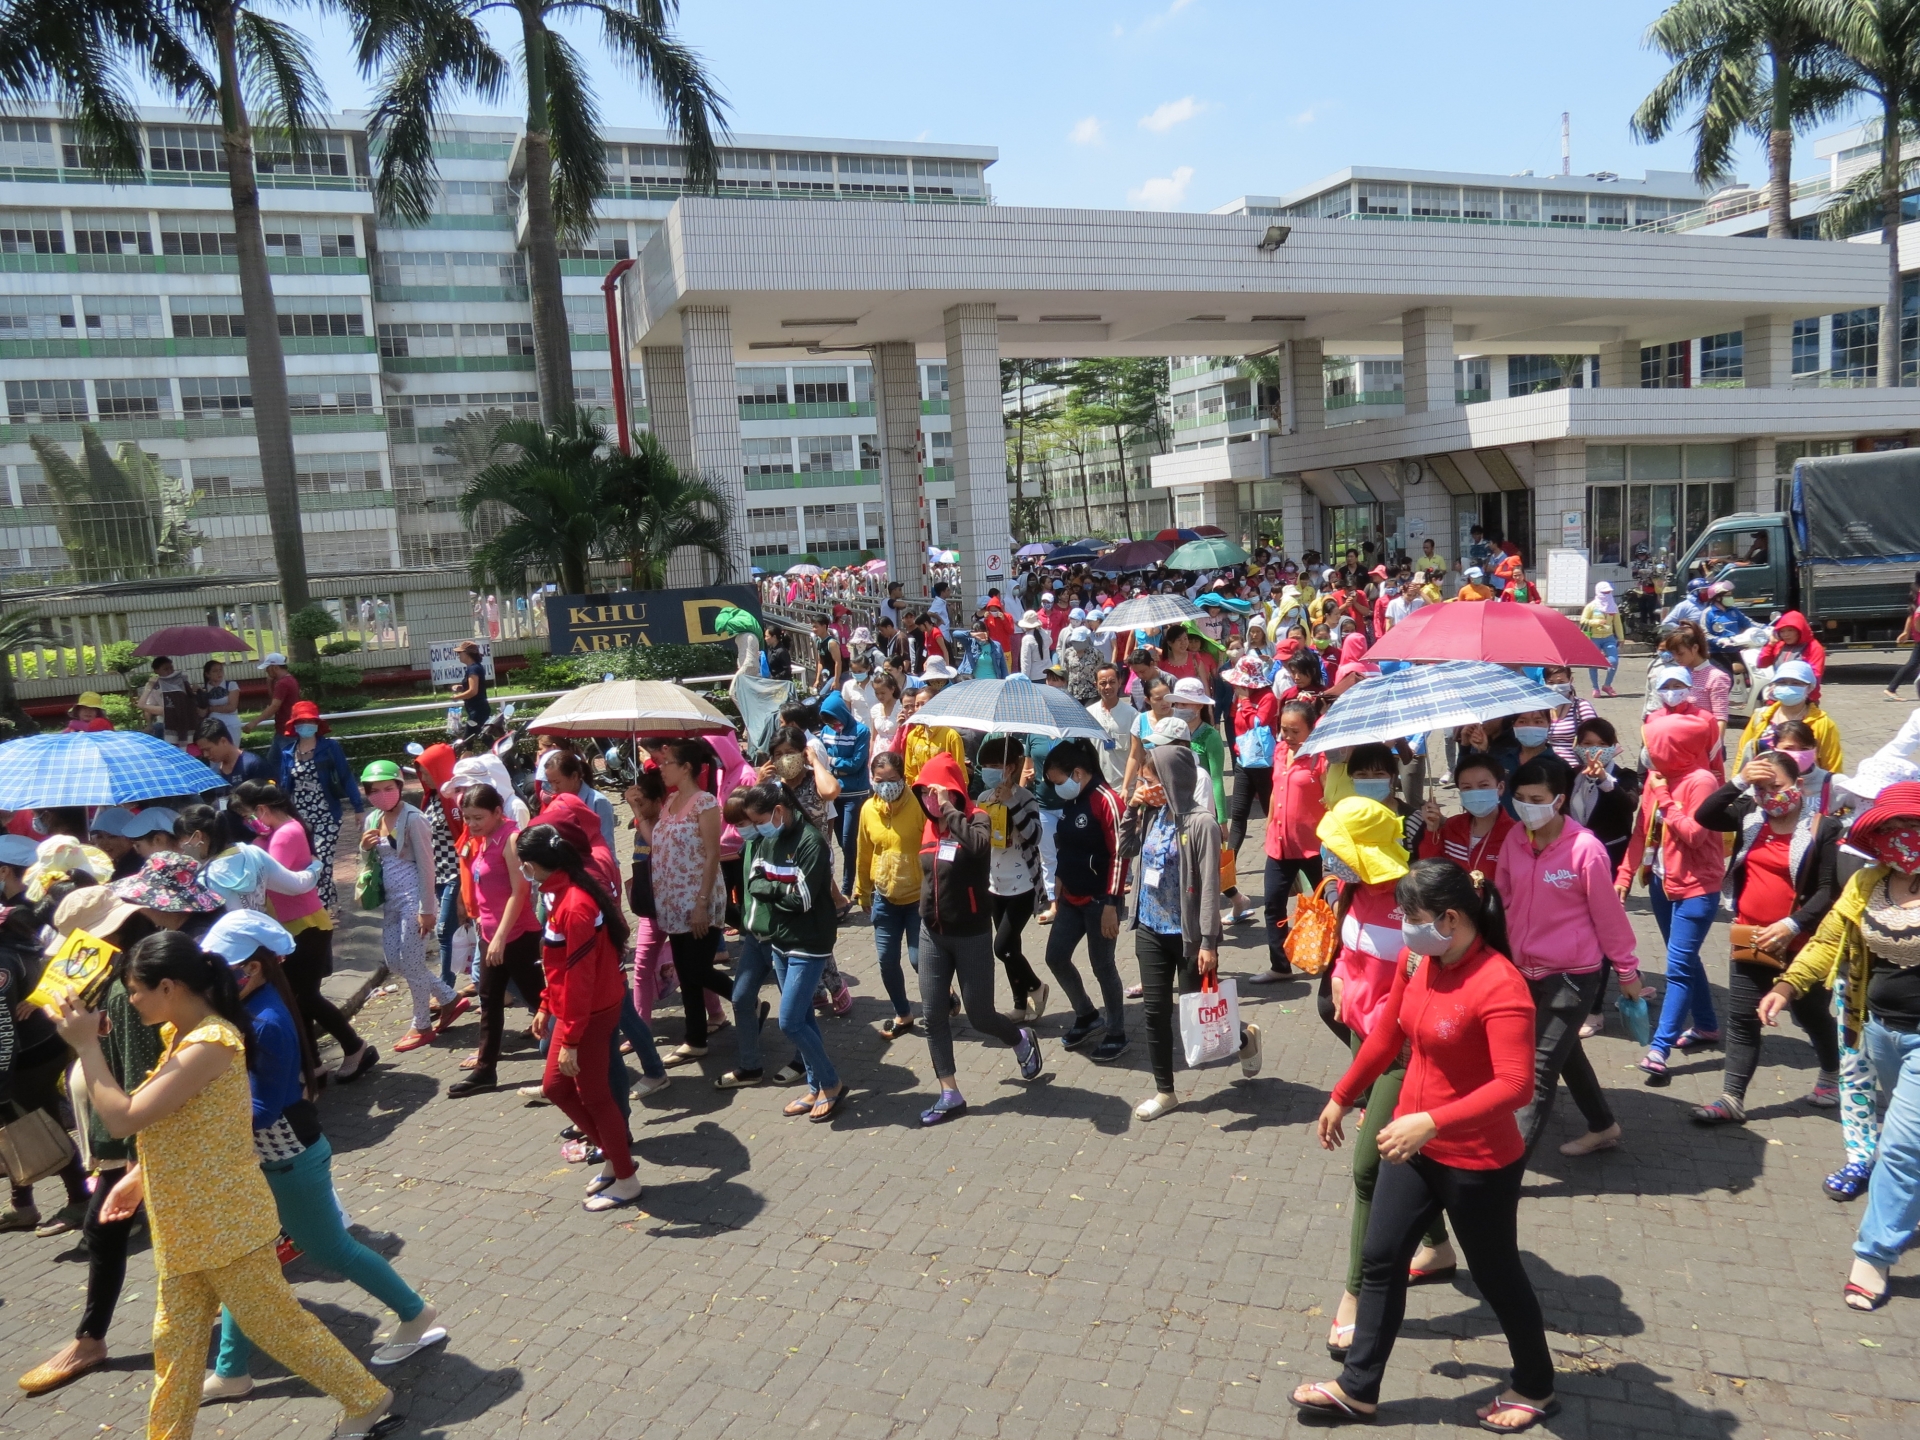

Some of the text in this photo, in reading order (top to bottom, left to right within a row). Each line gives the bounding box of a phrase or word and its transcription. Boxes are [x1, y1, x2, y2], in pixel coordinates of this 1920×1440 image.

[567, 602, 648, 625] KHU
[682, 598, 739, 645] D
[569, 631, 653, 653] AREA
[430, 648, 442, 663] COI
[1387, 913, 1404, 921] adid
